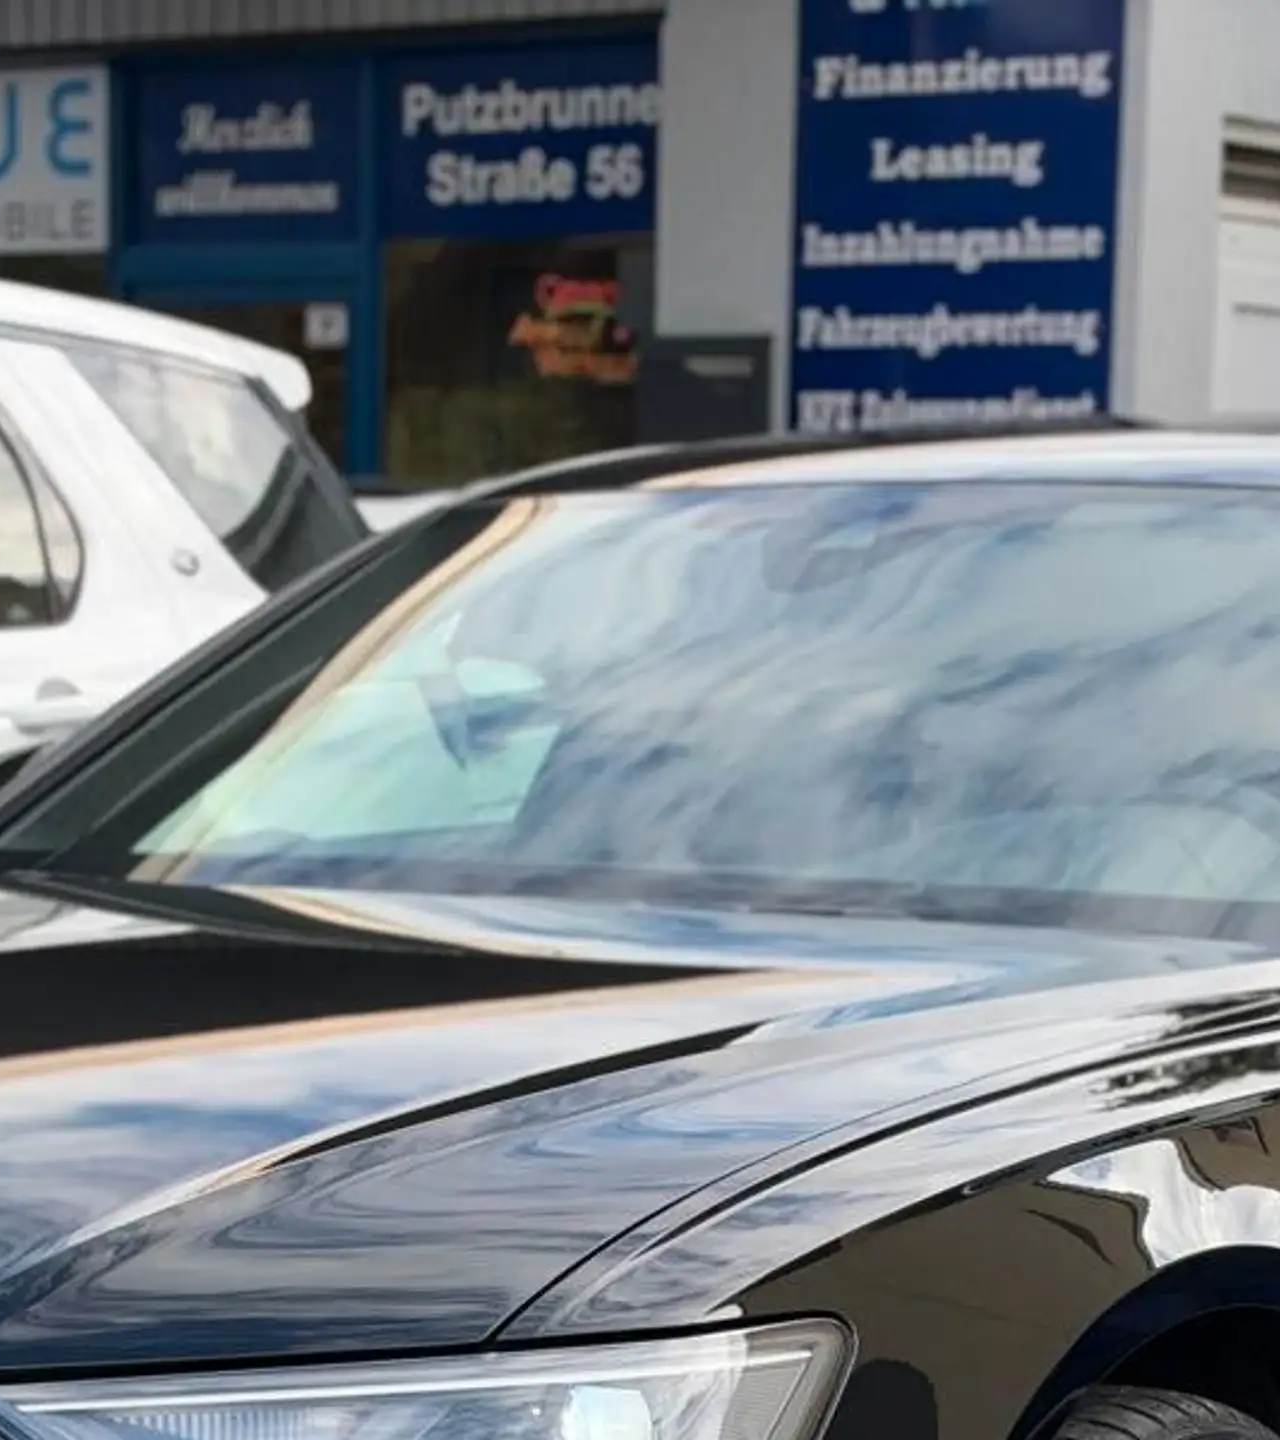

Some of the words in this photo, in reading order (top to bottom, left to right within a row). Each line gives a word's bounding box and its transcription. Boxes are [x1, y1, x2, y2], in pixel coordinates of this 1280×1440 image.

[813, 45, 1113, 100] Finanzierung
[425, 146, 577, 207] Straße
[585, 142, 645, 200] 56
[870, 131, 1045, 188] Leasing
